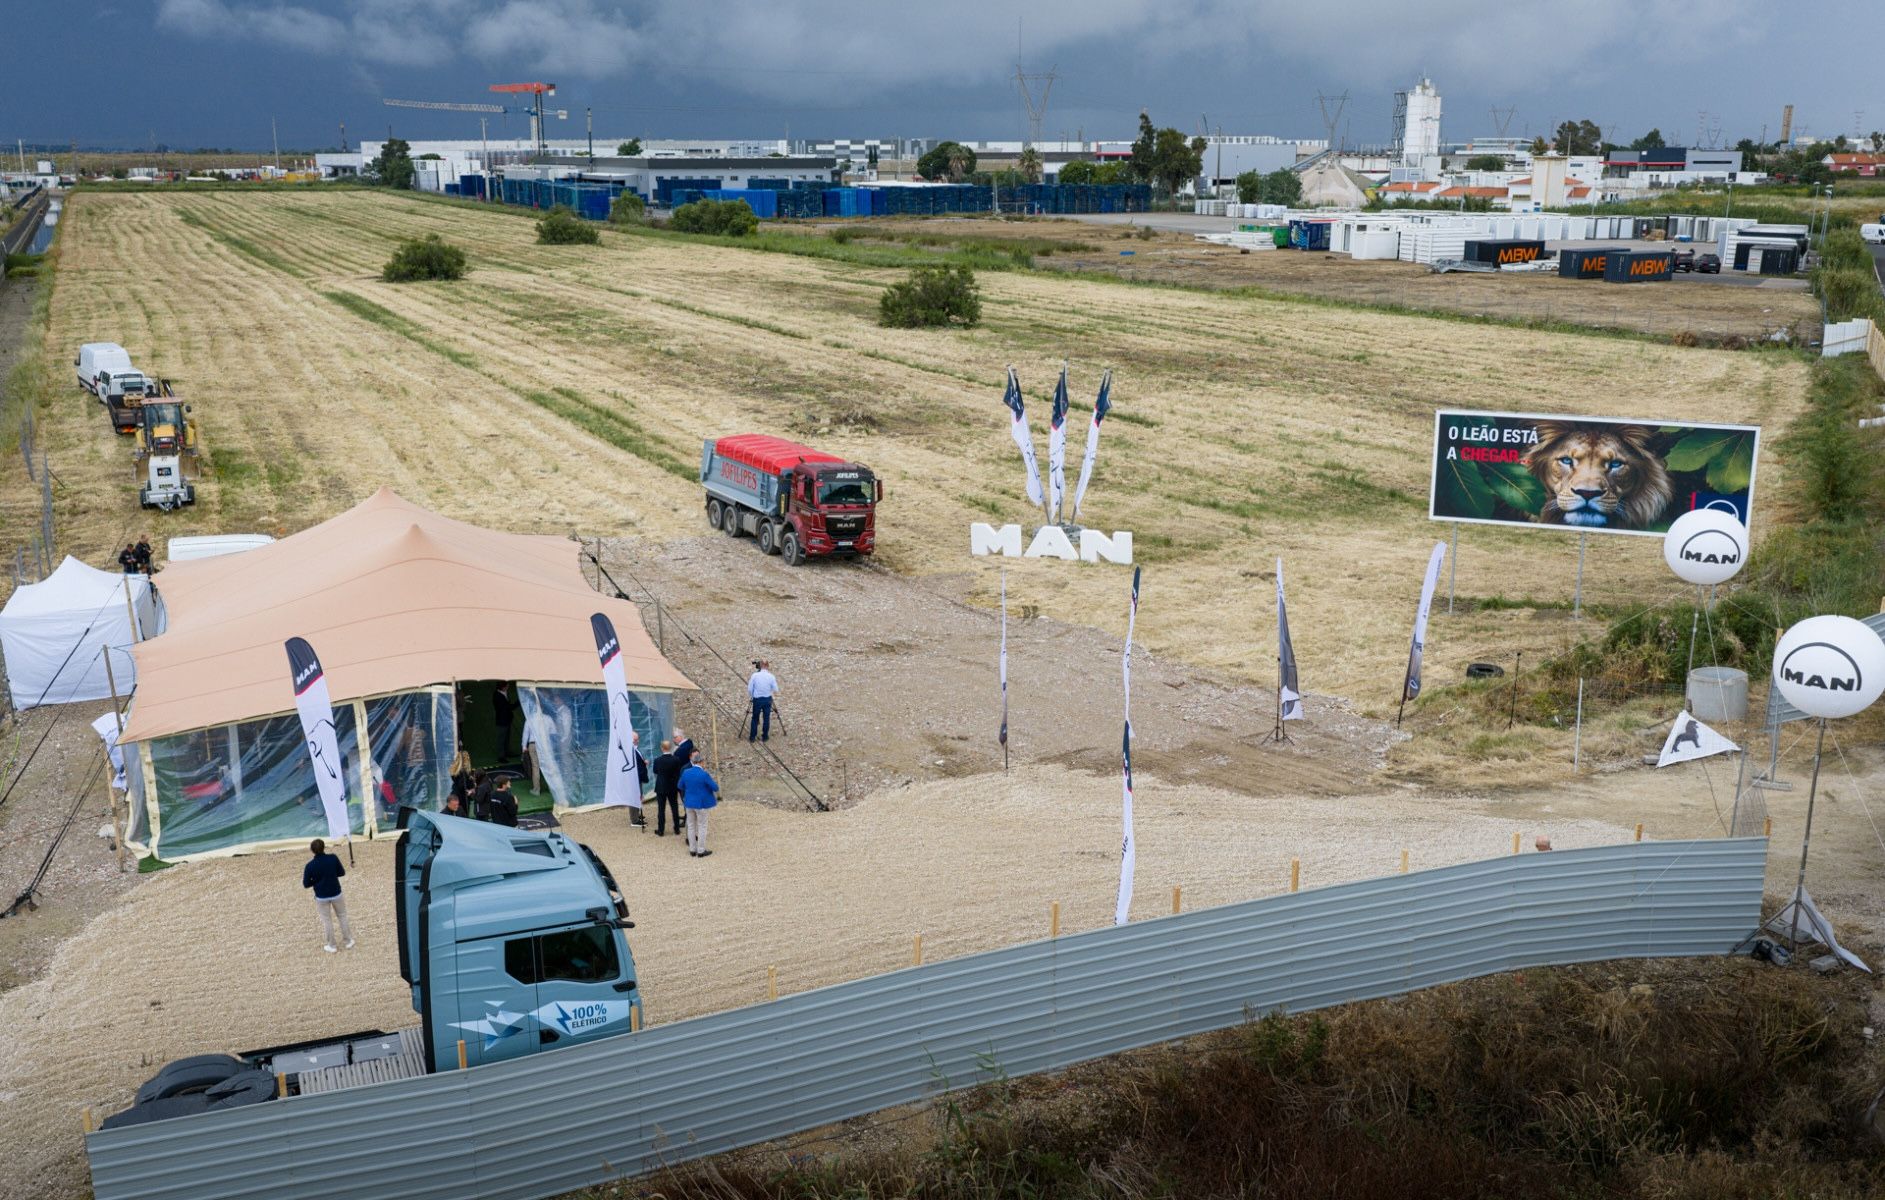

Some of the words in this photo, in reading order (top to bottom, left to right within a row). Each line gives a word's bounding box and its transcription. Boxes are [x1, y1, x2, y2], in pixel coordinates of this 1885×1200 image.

[1498, 247, 1539, 263] MBW
[1630, 259, 1668, 276] MBW
[1448, 426, 1459, 440] O
[1462, 424, 1499, 442] LEÃO
[1502, 427, 1538, 444] ESTÁ
[1446, 446, 1457, 460] A
[970, 522, 1133, 565] MAN
[1685, 550, 1737, 565] MAN
[1784, 667, 1855, 692] MAN
[571, 1003, 607, 1020] 100%
